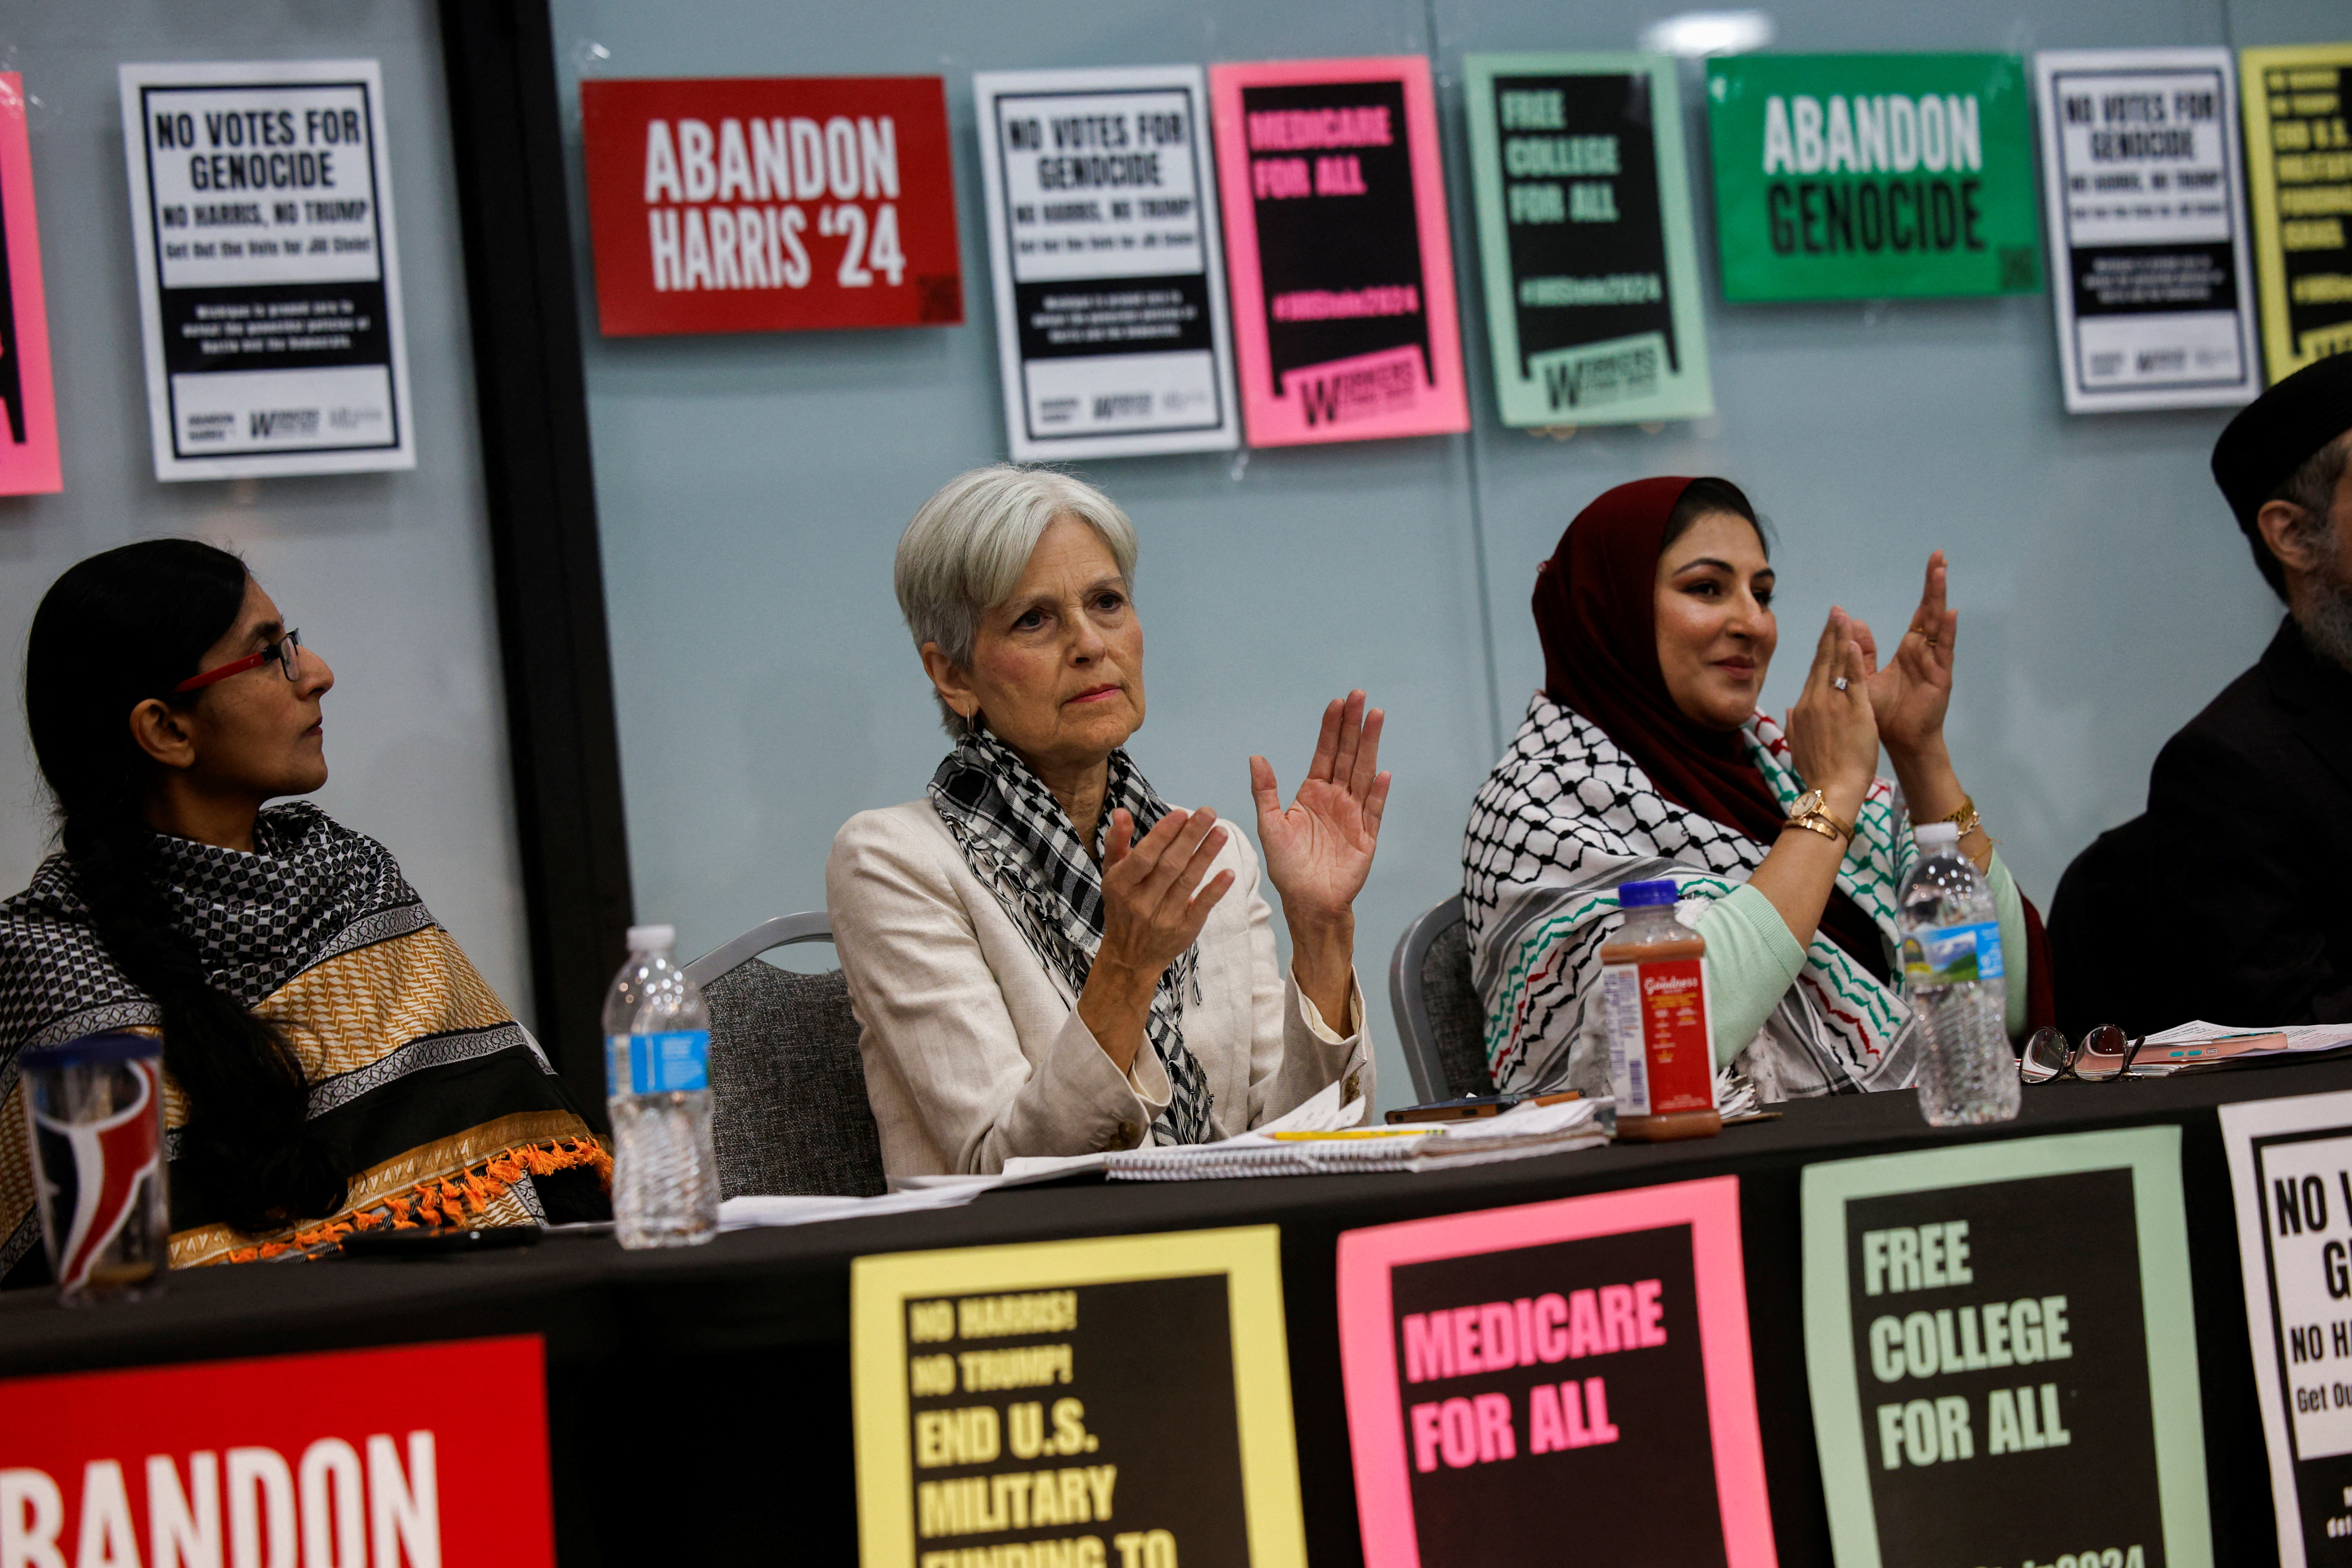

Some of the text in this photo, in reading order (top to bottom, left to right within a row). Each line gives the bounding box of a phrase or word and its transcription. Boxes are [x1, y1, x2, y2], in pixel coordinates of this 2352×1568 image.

[156, 109, 361, 150] NO VOTES FOR
[1009, 113, 1184, 150] NO VOTES FOR
[1248, 105, 1393, 153] MEDICARE
[1501, 89, 1567, 130] FREE
[2066, 91, 2212, 123] NO VOTES FOR
[1505, 134, 1622, 178] COLLEGE
[1762, 92, 1983, 176] ABANDON
[2092, 130, 2192, 161] GENOCIDE
[190, 151, 337, 192] GENOCIDE
[644, 115, 900, 204] ABANDON
[1039, 153, 1163, 190] GENOCIDE
[1253, 154, 1367, 200] FOR ALL
[163, 199, 367, 229] NO HARRIS, NO TRUMP
[1508, 181, 1620, 224] FOR ALL
[1767, 177, 1986, 256] GENOCIDE
[648, 202, 906, 292] HARRIS ‘24
[2274, 1174, 2328, 1237] NO
[1863, 1220, 1973, 1296] FREE
[909, 1290, 1078, 1344] NO HARRIS!
[1402, 1279, 1667, 1383] MEDICARE
[1868, 1295, 2072, 1383] COLLEGE
[2291, 1324, 2324, 1364] NO
[910, 1344, 1073, 1397] NO TRUMP!
[2298, 1385, 2327, 1413] Get
[916, 1397, 1099, 1468] END U.S.
[1410, 1376, 1619, 1474] FOR ALL
[1877, 1383, 2071, 1470] FOR ALL
[0, 1429, 443, 1568] BANDON
[919, 1464, 1117, 1538] MILITARY
[1114, 1529, 1177, 1568] TO
